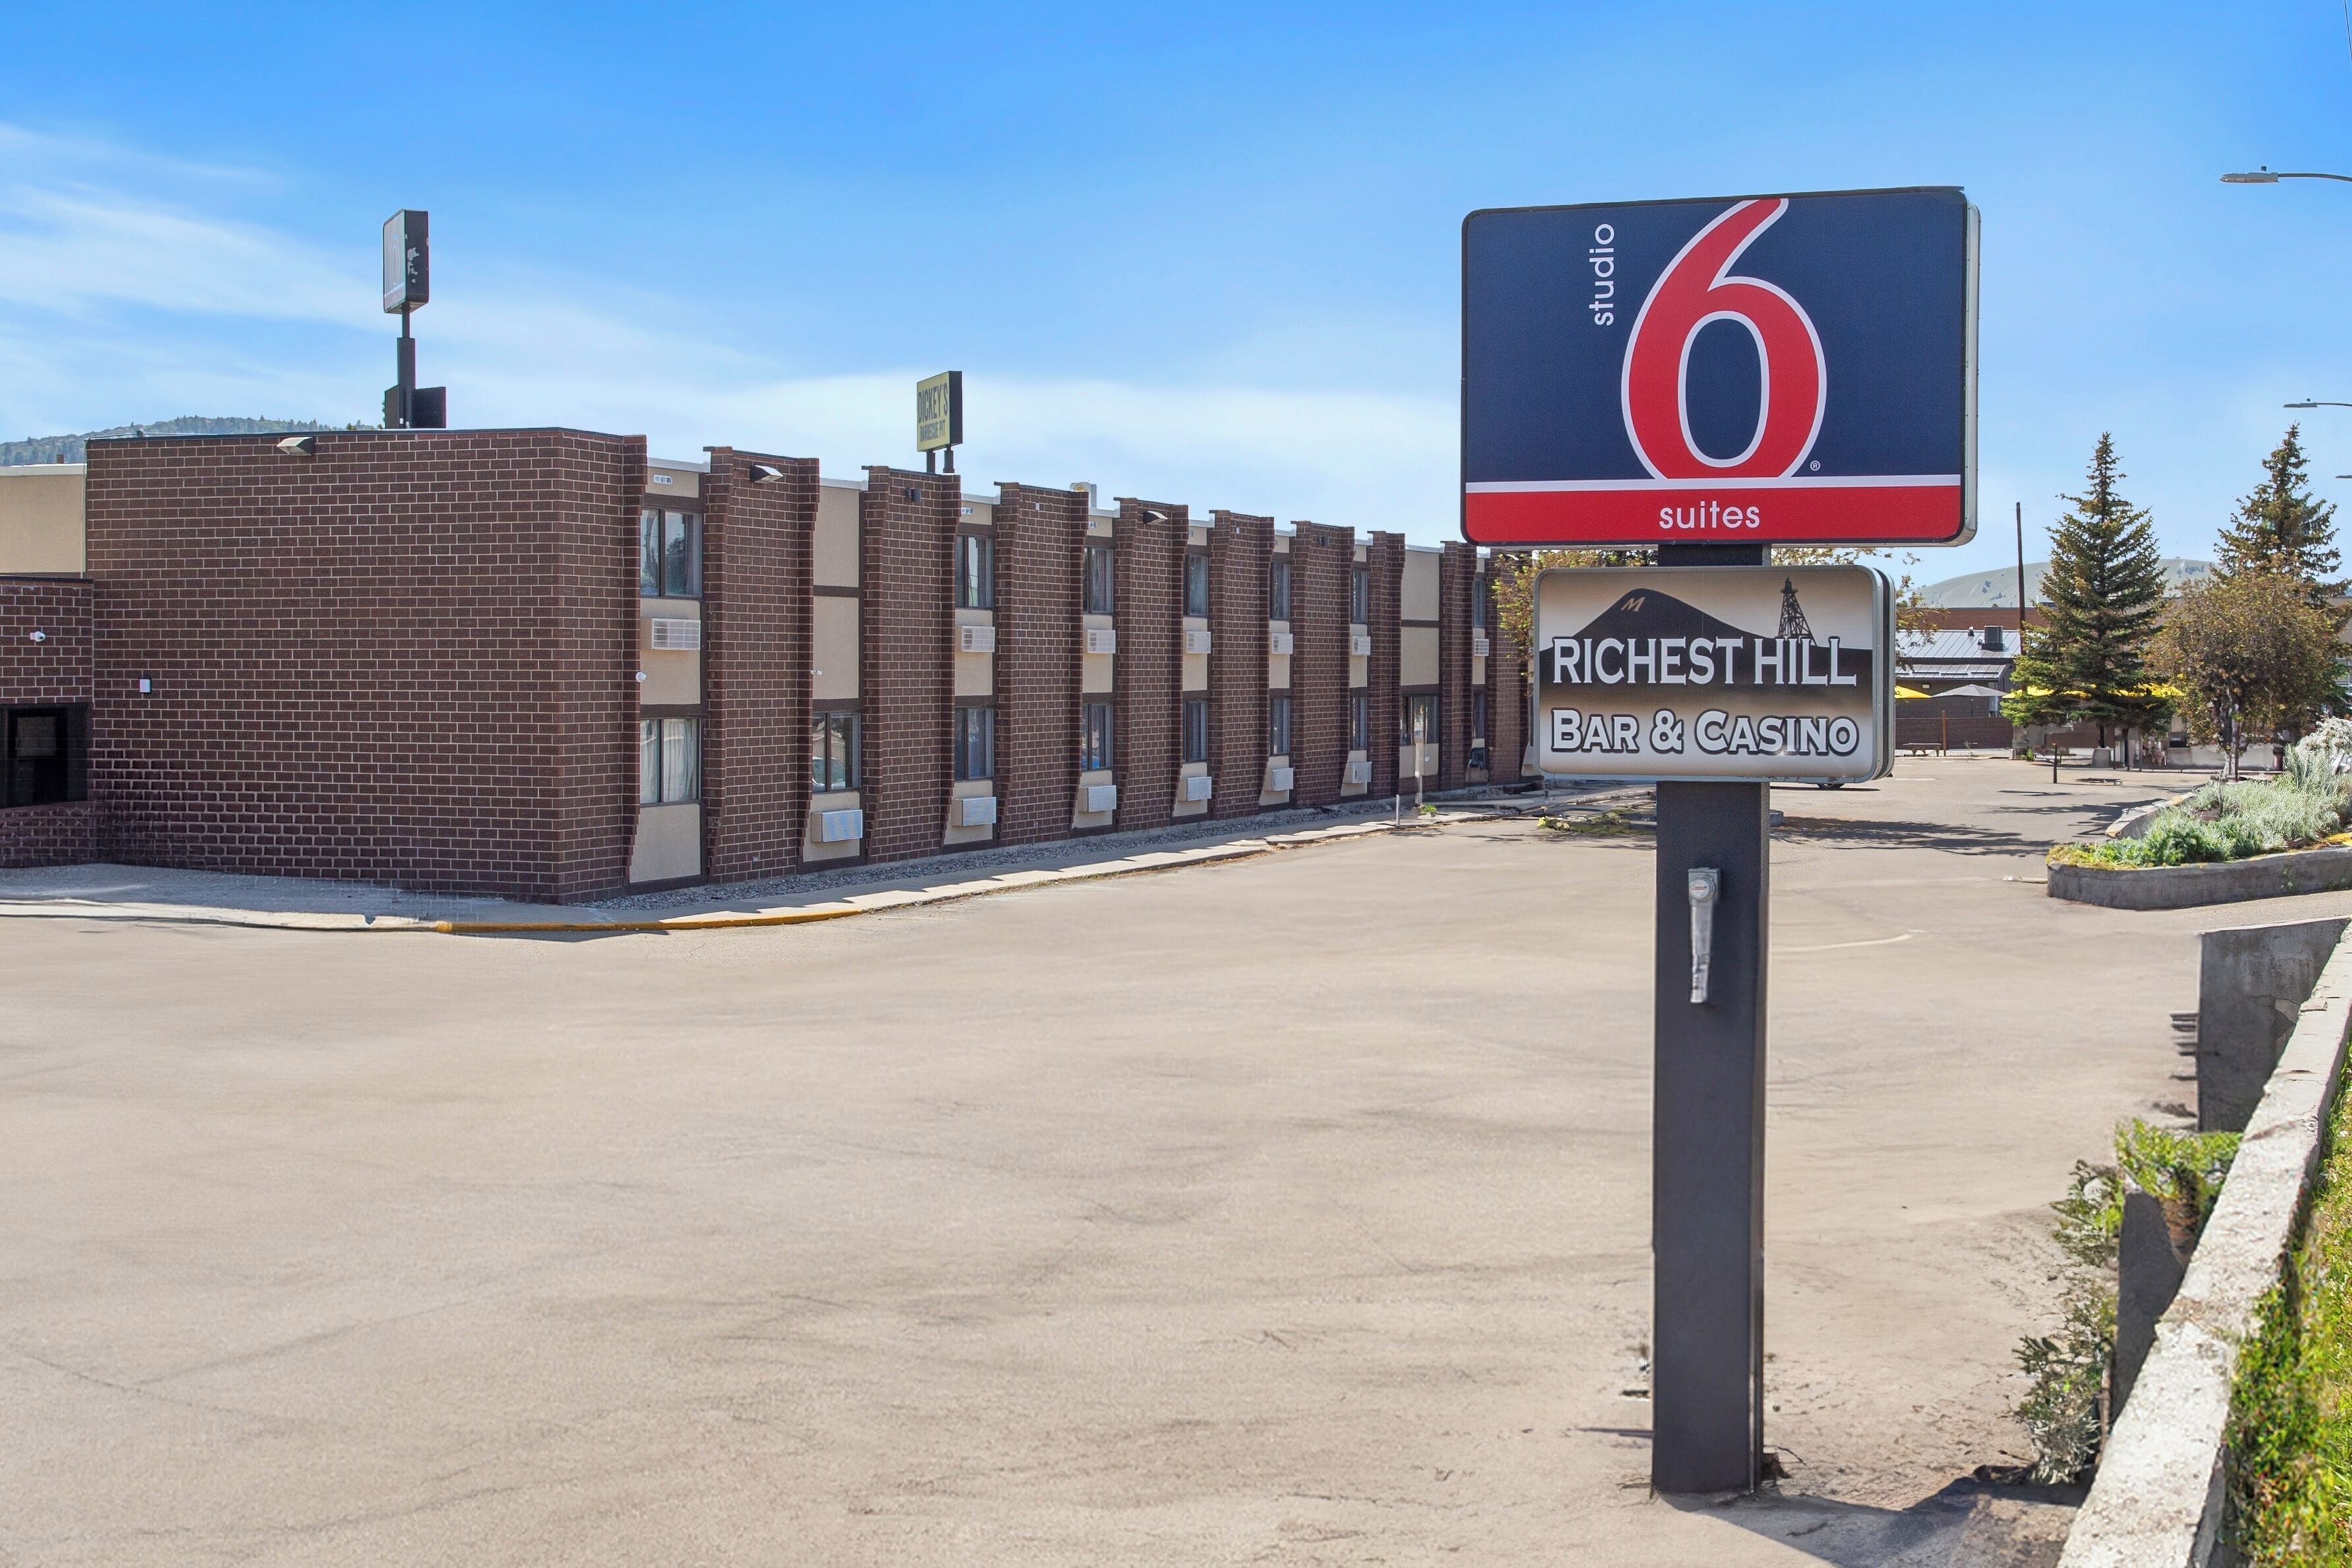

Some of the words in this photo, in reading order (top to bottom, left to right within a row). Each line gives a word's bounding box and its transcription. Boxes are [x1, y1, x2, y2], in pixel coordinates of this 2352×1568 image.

[1589, 223, 1615, 326] studio
[1621, 198, 1827, 479] 6
[918, 382, 948, 423] DICKEY'S
[1659, 500, 1761, 529] suites
[1621, 597, 1646, 612] M
[1552, 636, 1744, 685] RICHEST
[1755, 636, 1857, 686] HILL
[1552, 708, 1640, 753] BAR
[1650, 708, 1683, 754] &
[1695, 709, 1859, 756] CASINO
